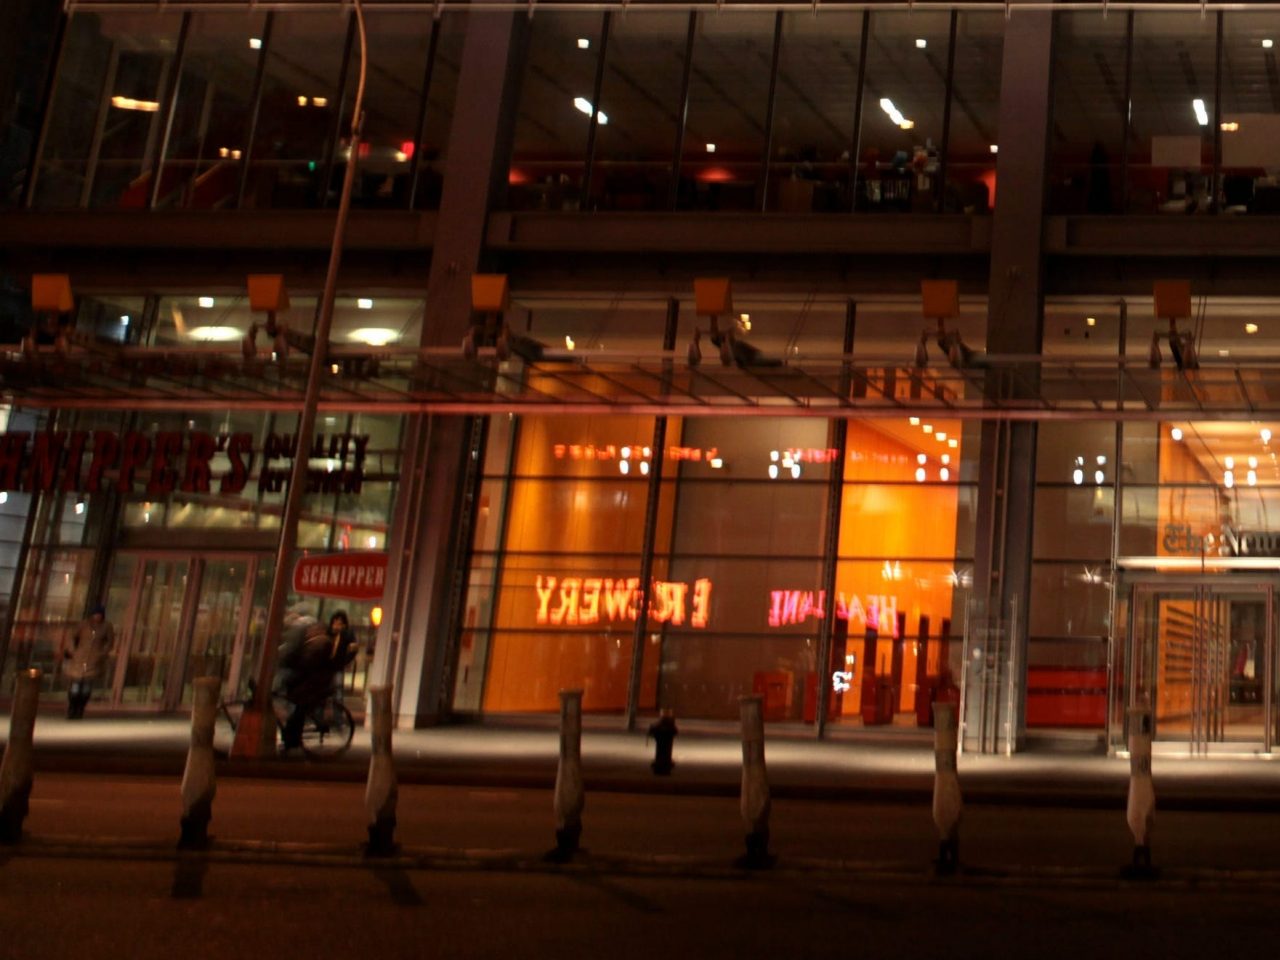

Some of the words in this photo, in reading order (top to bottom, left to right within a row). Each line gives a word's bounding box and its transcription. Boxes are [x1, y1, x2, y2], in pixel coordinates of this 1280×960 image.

[265, 433, 369, 458] QULITY
[1163, 524, 1214, 555] The
[1218, 524, 1278, 556] New
